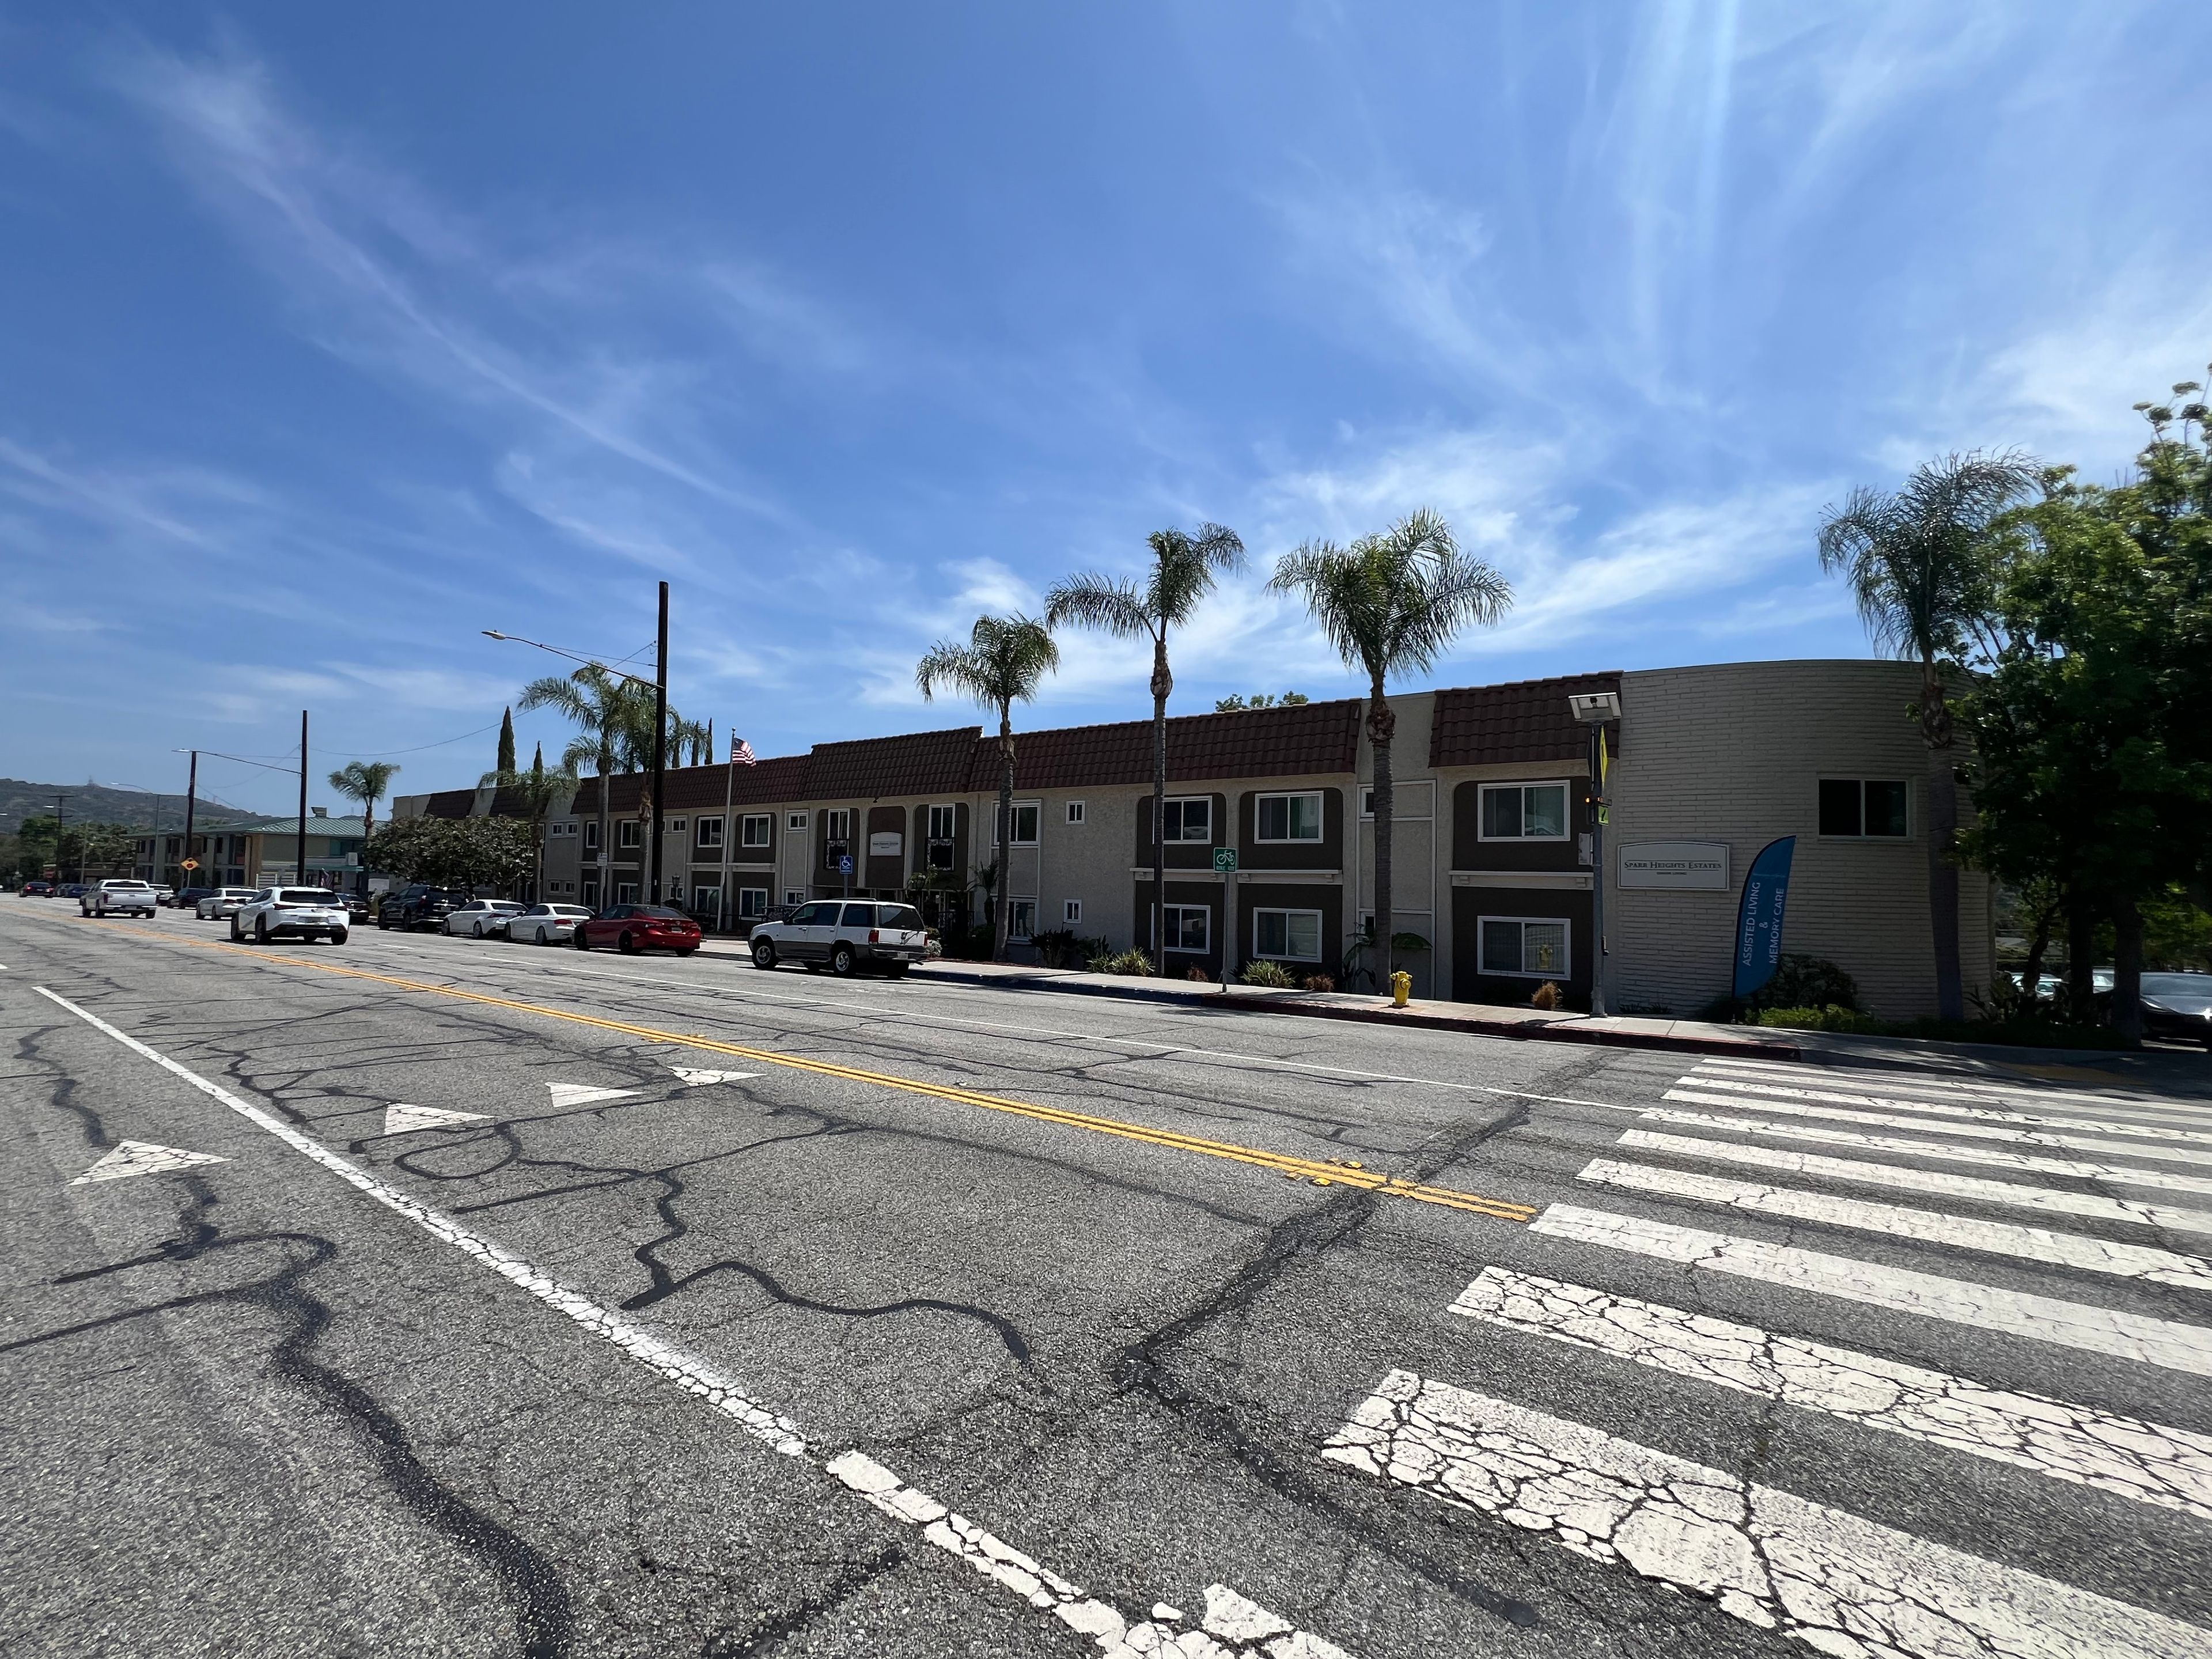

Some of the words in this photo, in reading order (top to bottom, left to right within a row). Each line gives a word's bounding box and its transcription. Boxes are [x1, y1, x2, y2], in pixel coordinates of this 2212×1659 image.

[1747, 882, 1760, 915] LIVING
[1773, 888, 1784, 915] CARE
[1743, 918, 1755, 967] ASSISTED
[1769, 918, 1779, 964] MEMORY
